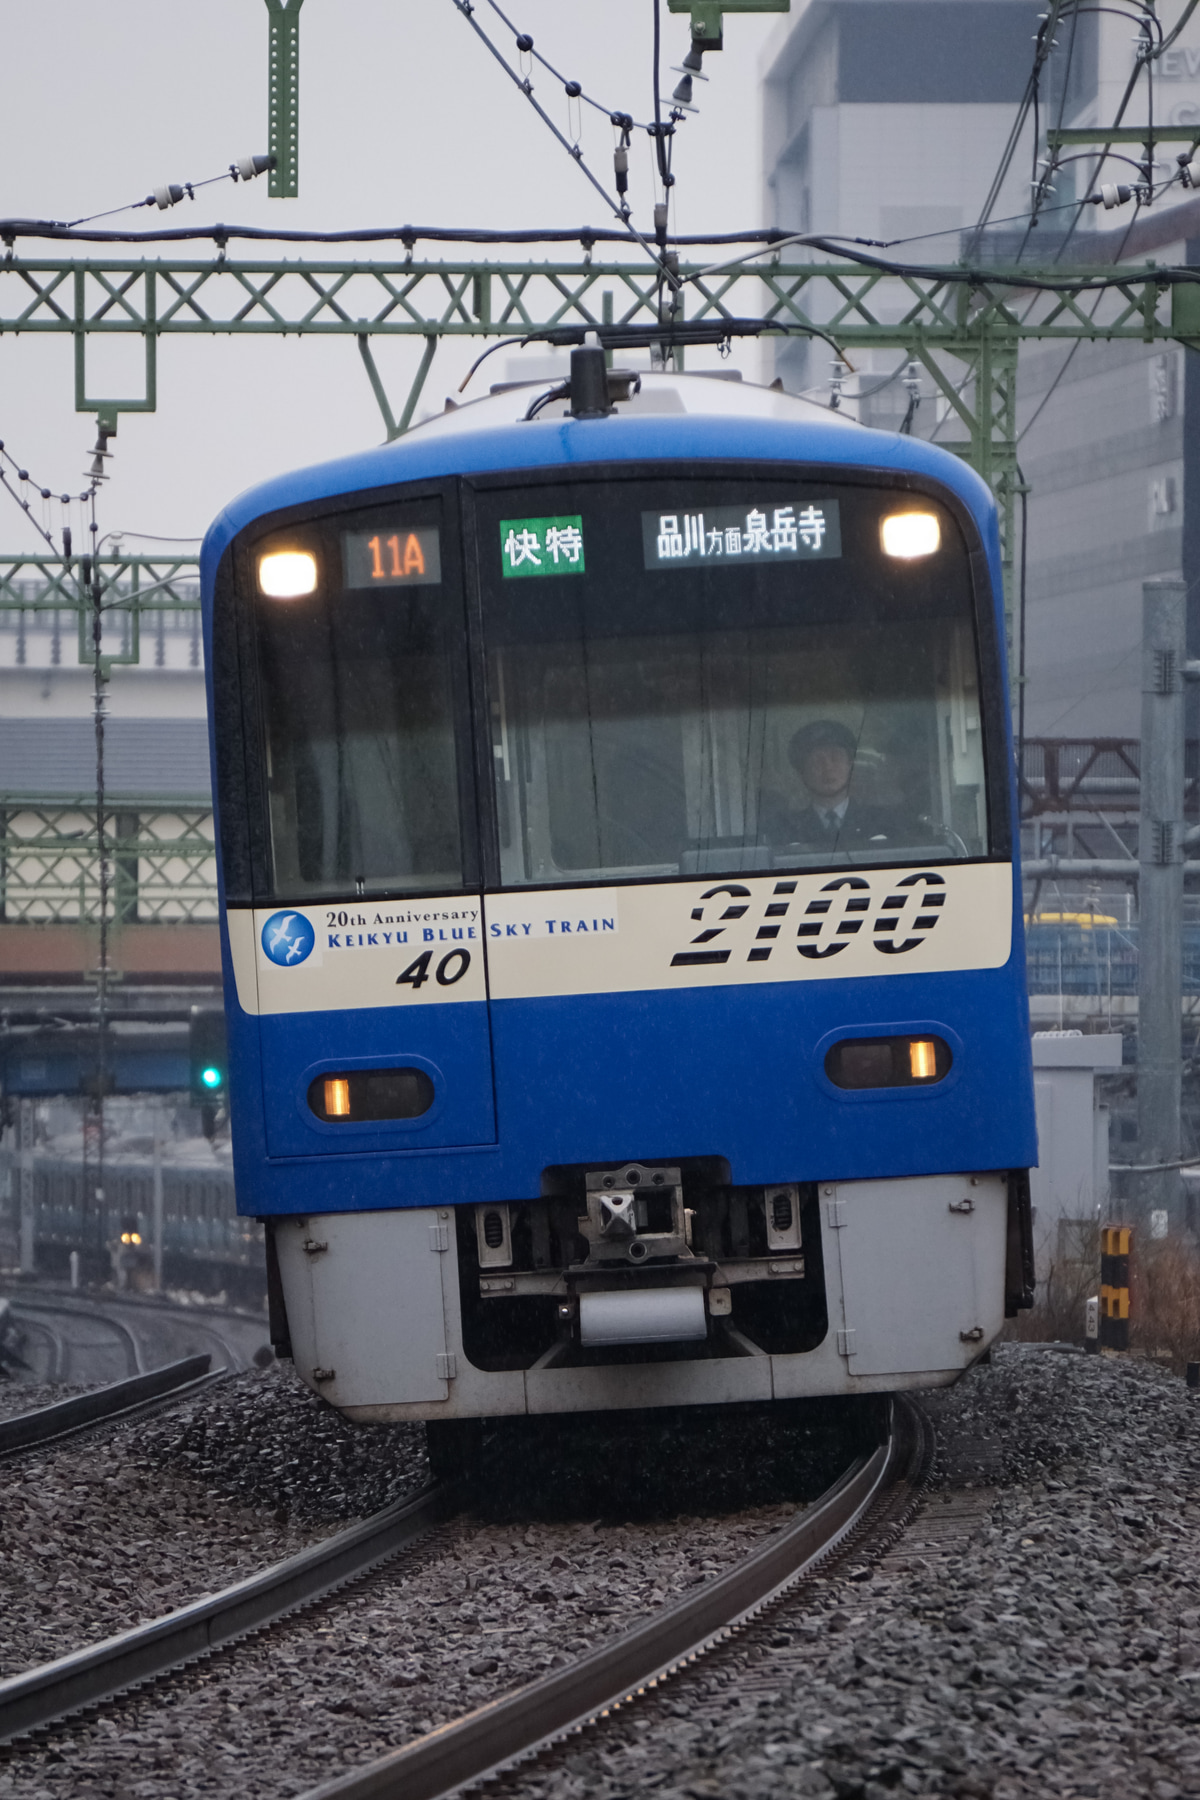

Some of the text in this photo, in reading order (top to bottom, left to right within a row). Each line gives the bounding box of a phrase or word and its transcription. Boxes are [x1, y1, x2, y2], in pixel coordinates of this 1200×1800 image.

[368, 533, 425, 577] 11A
[504, 525, 583, 567] 快特
[326, 910, 479, 928] 20th Anniversary
[328, 918, 615, 948] KEIKYU BLUE SKY TRAIN
[669, 872, 947, 967] 2100
[396, 947, 471, 989] 40
